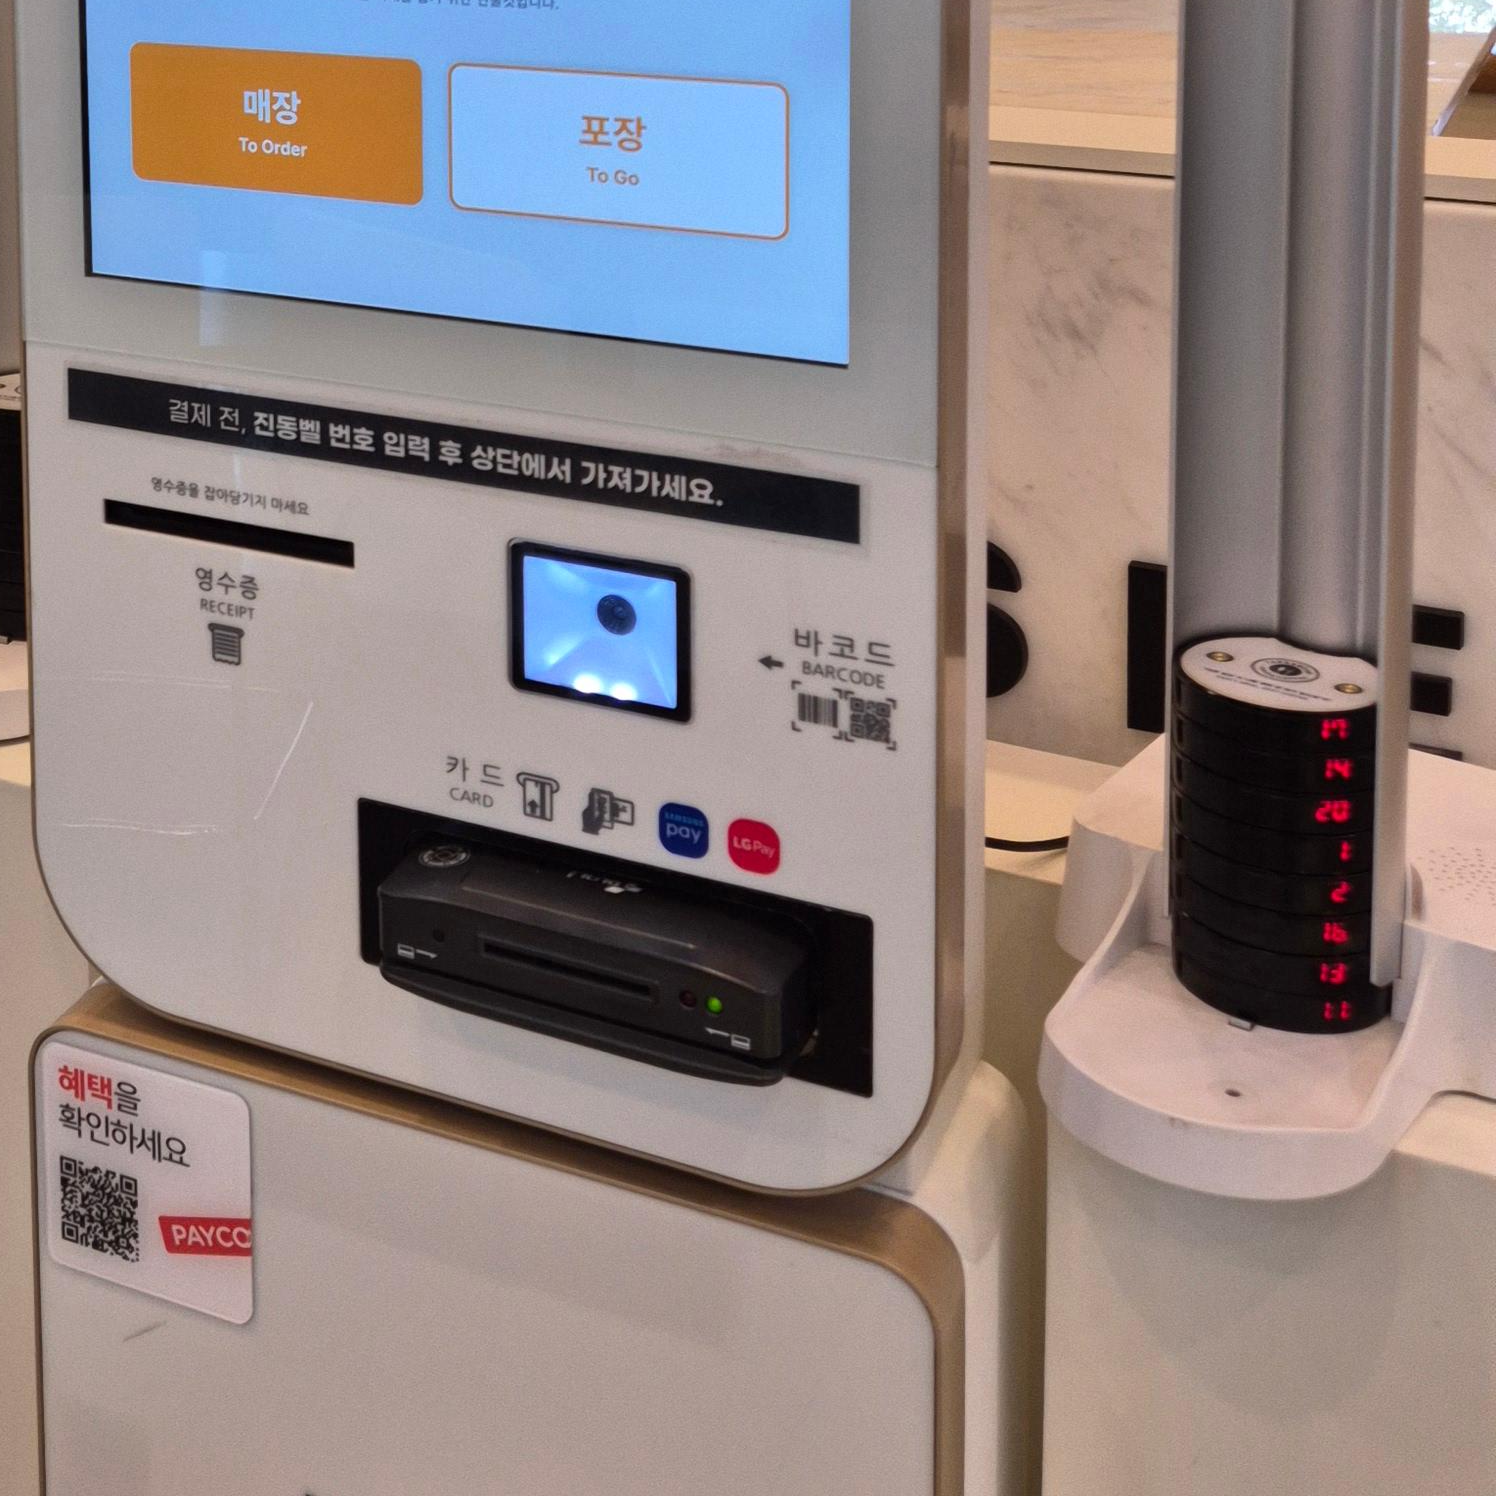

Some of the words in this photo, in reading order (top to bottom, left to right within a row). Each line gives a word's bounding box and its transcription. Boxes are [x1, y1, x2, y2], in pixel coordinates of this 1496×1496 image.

[241, 88, 302, 126] 매장
[239, 136, 259, 154] To
[262, 137, 308, 159] Order
[579, 115, 647, 153] 포장
[586, 165, 608, 185] To
[613, 167, 640, 187] Go
[167, 397, 212, 428] 결제
[219, 403, 248, 436] 전,
[252, 410, 322, 446] 진동벨
[327, 420, 376, 455] 번호
[382, 428, 431, 464] 입력
[438, 438, 463, 467] 후
[470, 442, 573, 485] 상단에서
[580, 458, 725, 509] 가져가세요.
[151, 476, 200, 498] 영수증을
[204, 485, 267, 510] 잡아당기지
[270, 496, 310, 516] 마세요
[195, 567, 260, 600] 영수증
[199, 598, 256, 621] RECEIPT
[794, 628, 896, 667] 바코드
[802, 660, 886, 690] BARCODE
[1321, 718, 1350, 741] 17
[446, 755, 505, 787] 카드
[1324, 757, 1353, 781] 14
[449, 787, 495, 809] CARD
[1315, 800, 1351, 823] 20
[666, 822, 702, 844] pay
[57, 1064, 142, 1117] 혜택을
[58, 1103, 191, 1168] 확인하세요
